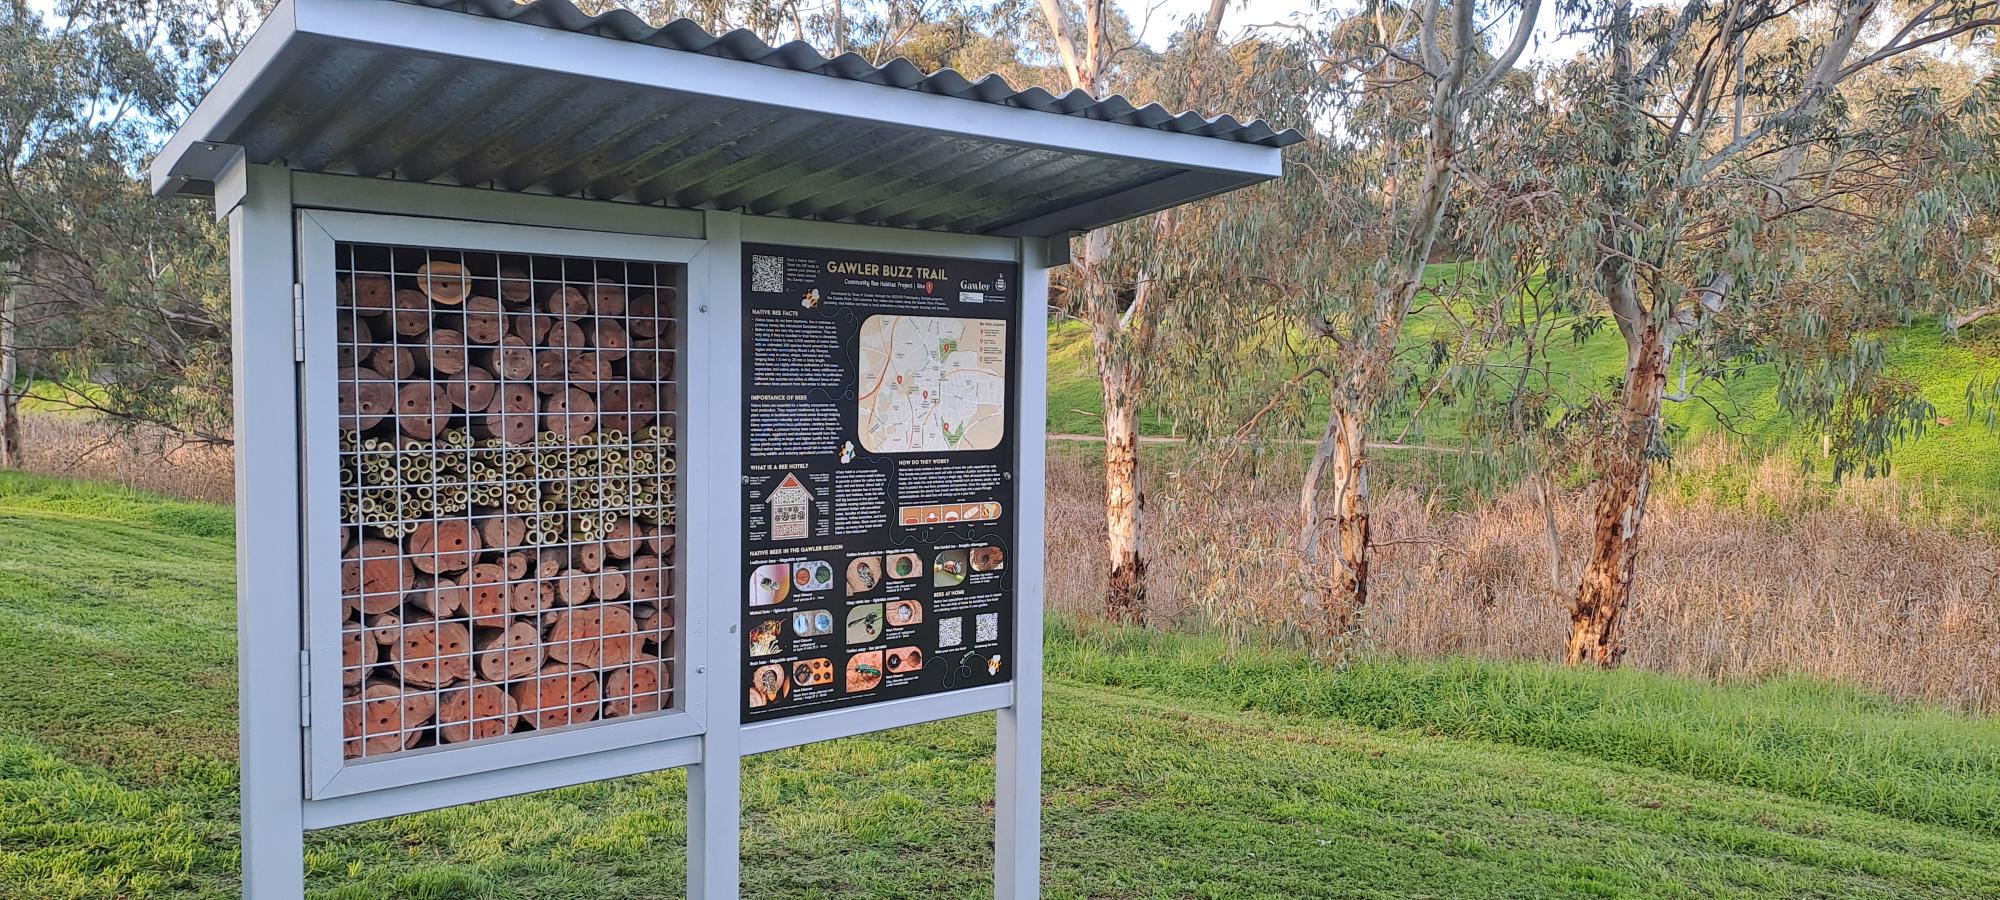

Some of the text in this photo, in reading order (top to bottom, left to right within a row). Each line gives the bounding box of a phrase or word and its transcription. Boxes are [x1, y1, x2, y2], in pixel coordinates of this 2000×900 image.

[826, 260, 880, 276] GAWLER
[882, 264, 913, 278] BUZZ
[916, 267, 948, 280] TRAIL
[844, 278, 870, 287] Community
[960, 280, 990, 290] Gawler
